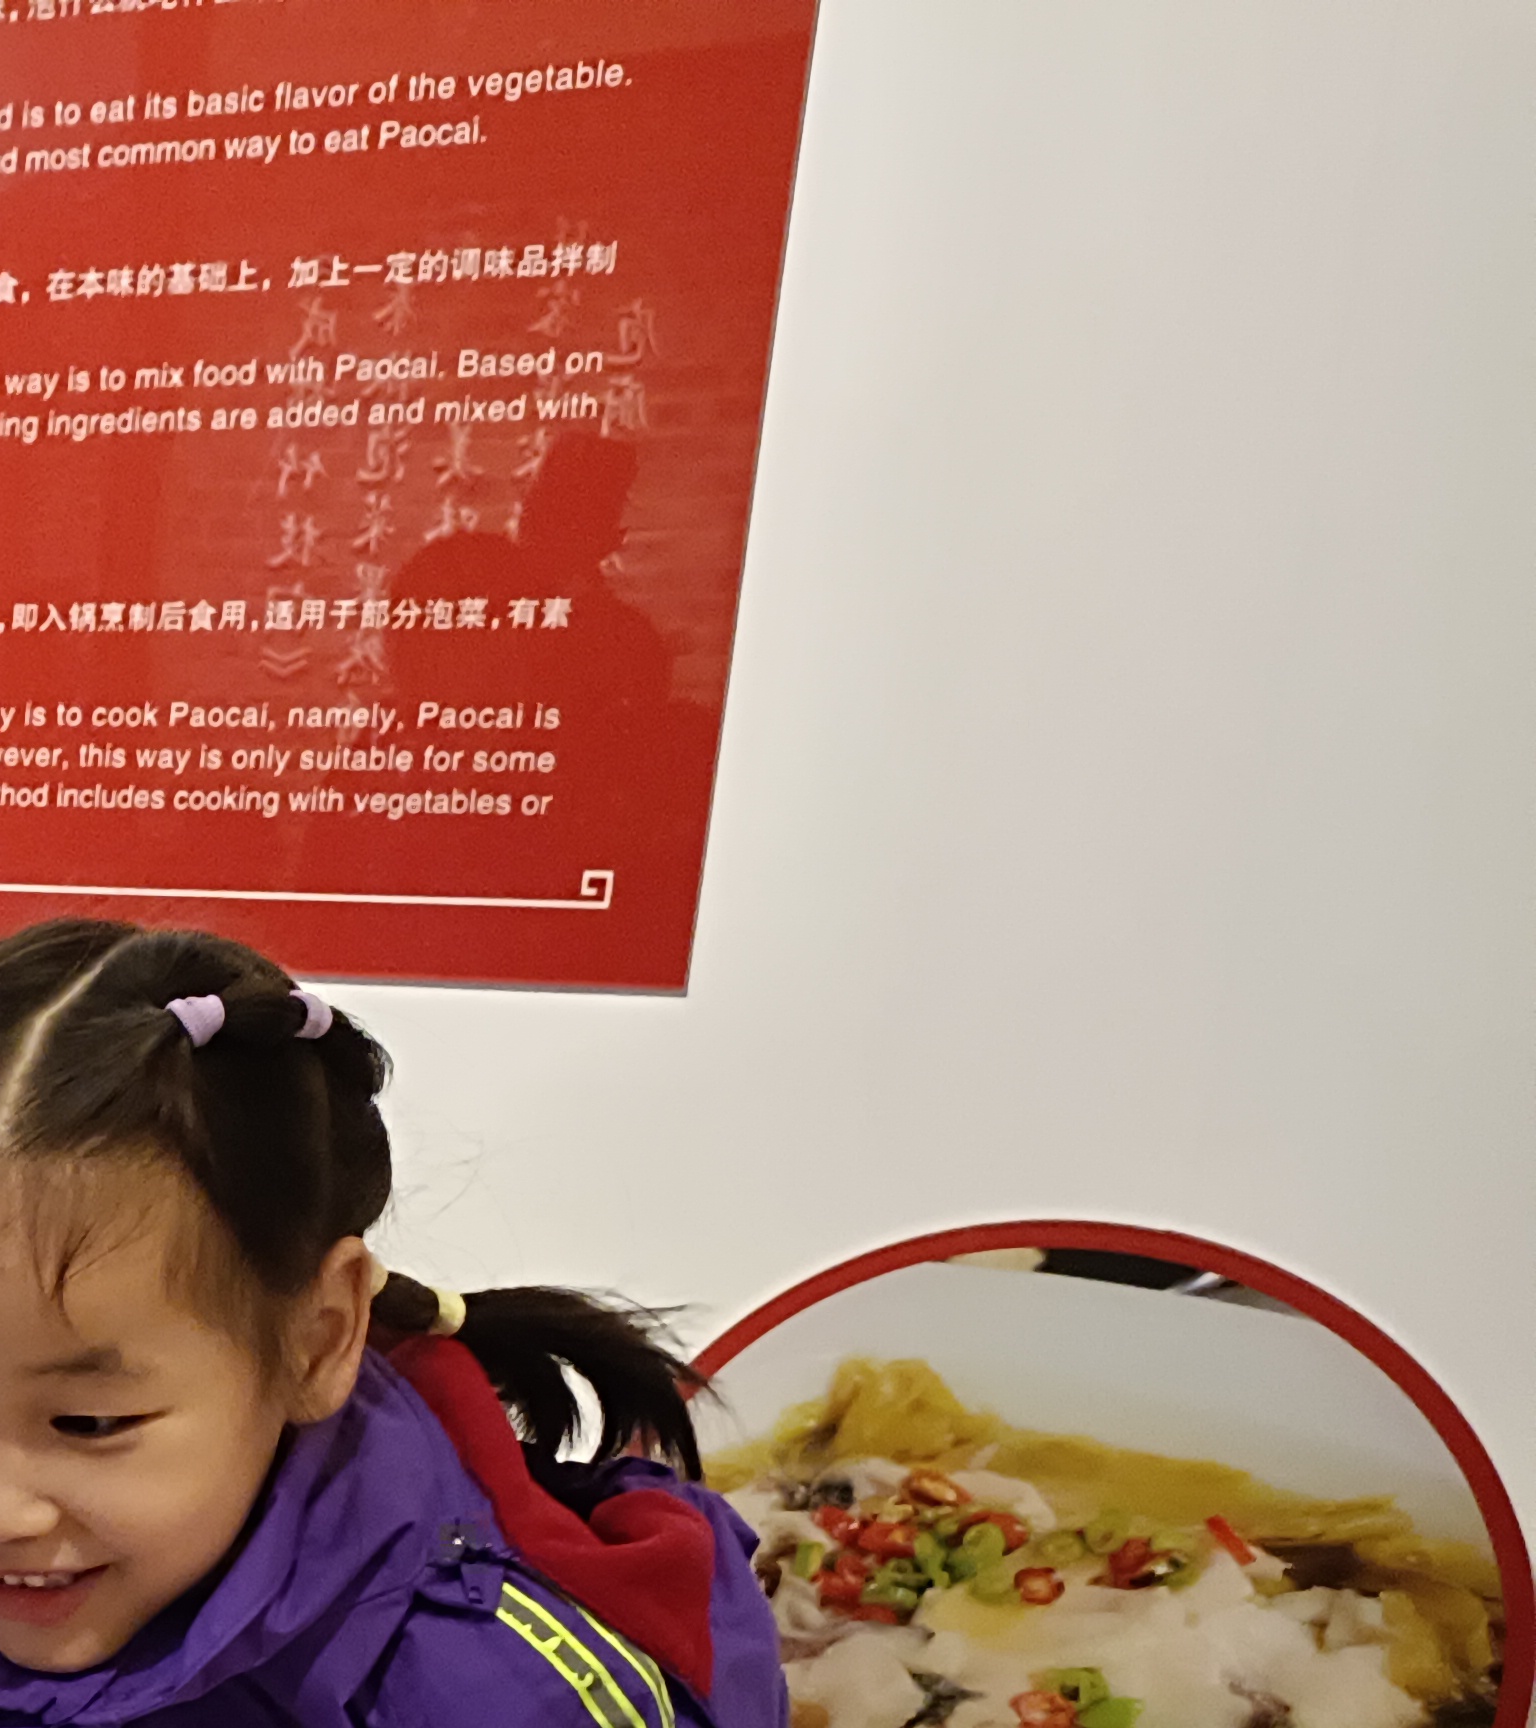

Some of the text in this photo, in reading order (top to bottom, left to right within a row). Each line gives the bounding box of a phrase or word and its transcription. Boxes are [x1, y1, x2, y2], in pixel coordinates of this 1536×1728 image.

[22, 100, 45, 130] is
[55, 101, 81, 127] to
[90, 94, 136, 125] eat
[144, 90, 177, 120] its
[187, 84, 265, 117] basic
[274, 81, 361, 112] flavor
[368, 72, 400, 106] of
[408, 72, 456, 102] the
[468, 58, 632, 102] vegetable.
[24, 143, 91, 174] most
[97, 138, 216, 169] common
[224, 133, 281, 164] way
[289, 128, 317, 155] to
[324, 124, 371, 154] eat
[378, 115, 487, 150] Paocai.
[5, 371, 60, 401] way
[67, 365, 90, 394] is
[100, 365, 127, 392] to
[134, 362, 184, 390] mix
[193, 357, 259, 388] food
[266, 354, 324, 384] with
[335, 351, 446, 383] Paocai.
[457, 346, 555, 379] Based
[565, 350, 604, 376] on
[47, 406, 202, 442] ingredients
[211, 408, 258, 430] are
[267, 392, 361, 429] added
[368, 391, 426, 424] and
[434, 391, 528, 422] mixed
[536, 388, 599, 421] with
[24, 700, 47, 727] is
[57, 702, 83, 727] to
[91, 701, 160, 730] cook
[169, 701, 276, 732] Paocai,
[286, 704, 405, 734] namely,
[417, 701, 525, 729] Paocai
[534, 702, 561, 730] is
[79, 742, 126, 768] this
[136, 747, 192, 776] way
[199, 743, 223, 770] is
[230, 744, 292, 777] only
[300, 742, 414, 773] suitable
[423, 744, 465, 773] for
[472, 750, 557, 773] some
[56, 781, 166, 809] includes
[173, 784, 280, 818] cooking
[288, 786, 345, 812] with
[350, 787, 512, 820] vegetables
[521, 794, 553, 816] or
